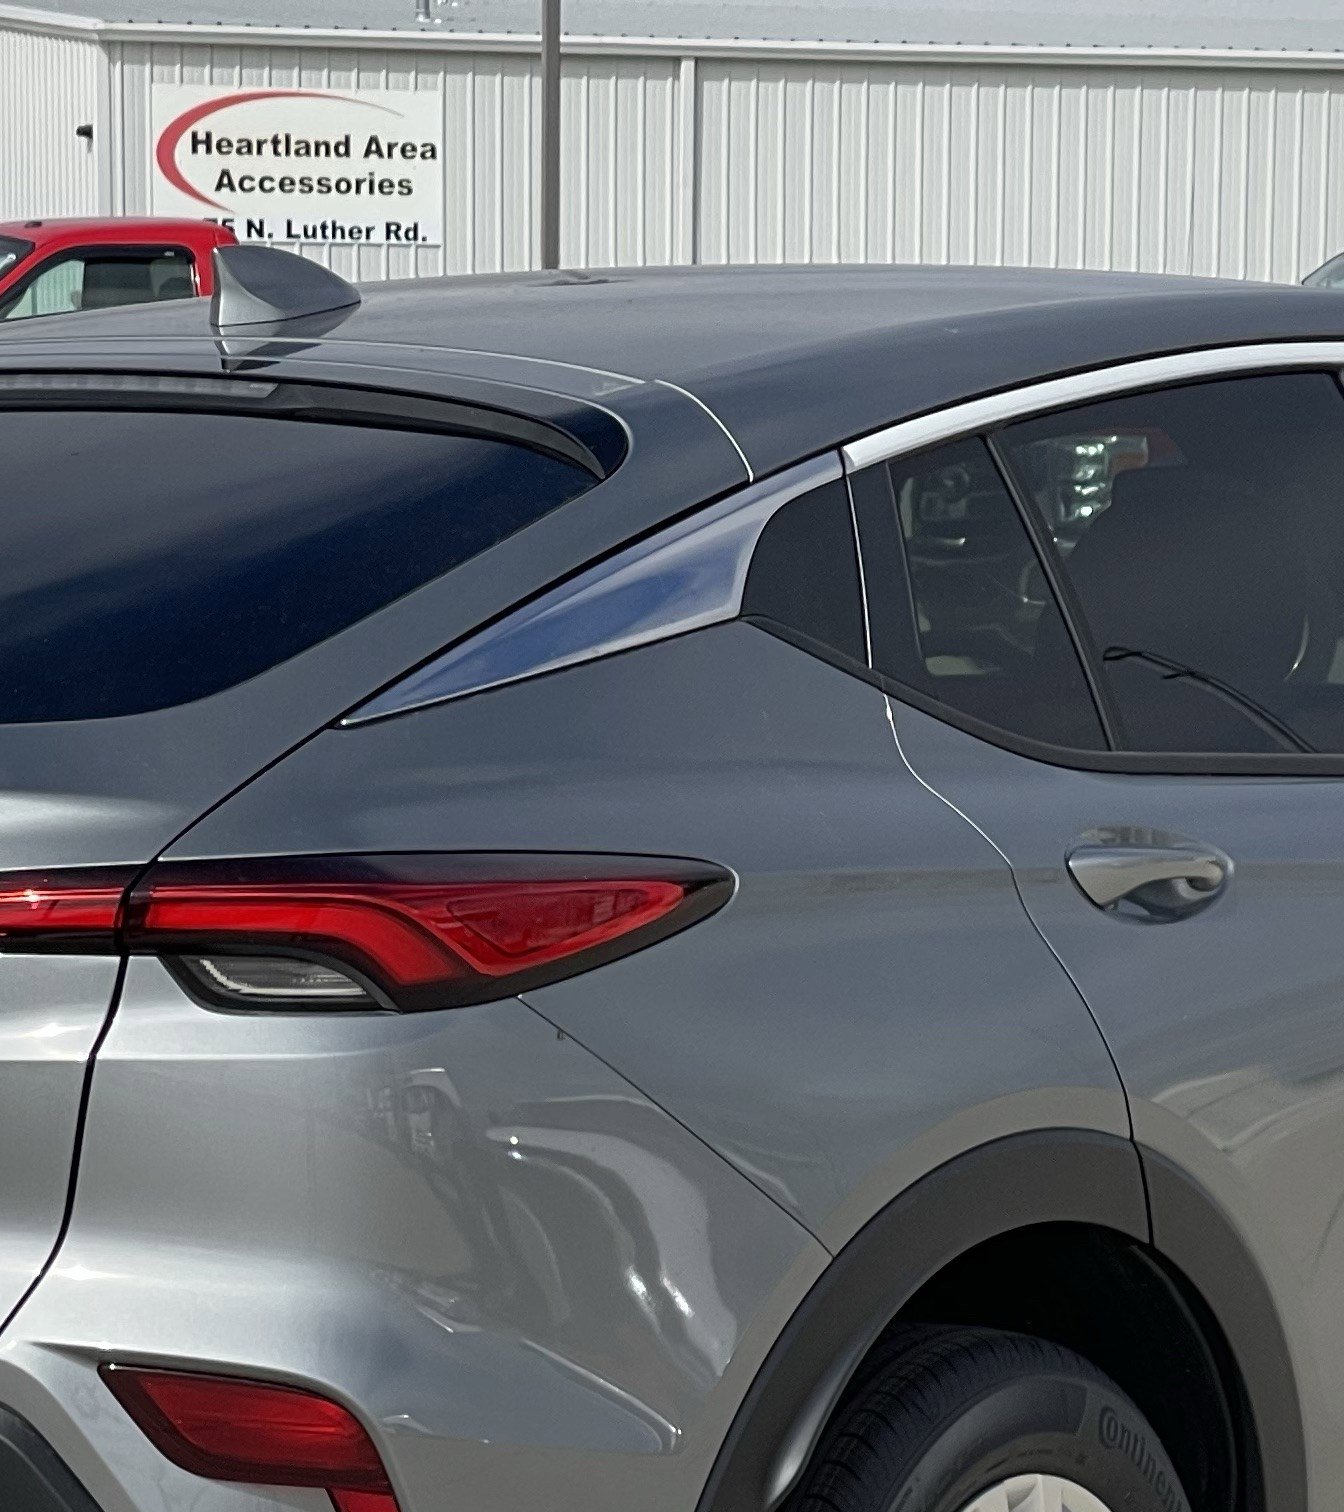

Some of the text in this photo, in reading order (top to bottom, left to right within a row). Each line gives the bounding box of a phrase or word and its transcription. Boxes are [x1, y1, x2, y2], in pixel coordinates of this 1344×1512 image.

[191, 131, 437, 160] Heartland Area
[214, 169, 413, 196] Accessories
[246, 219, 274, 238] N.
[286, 219, 375, 240] Luther
[385, 221, 428, 241] Rd.
